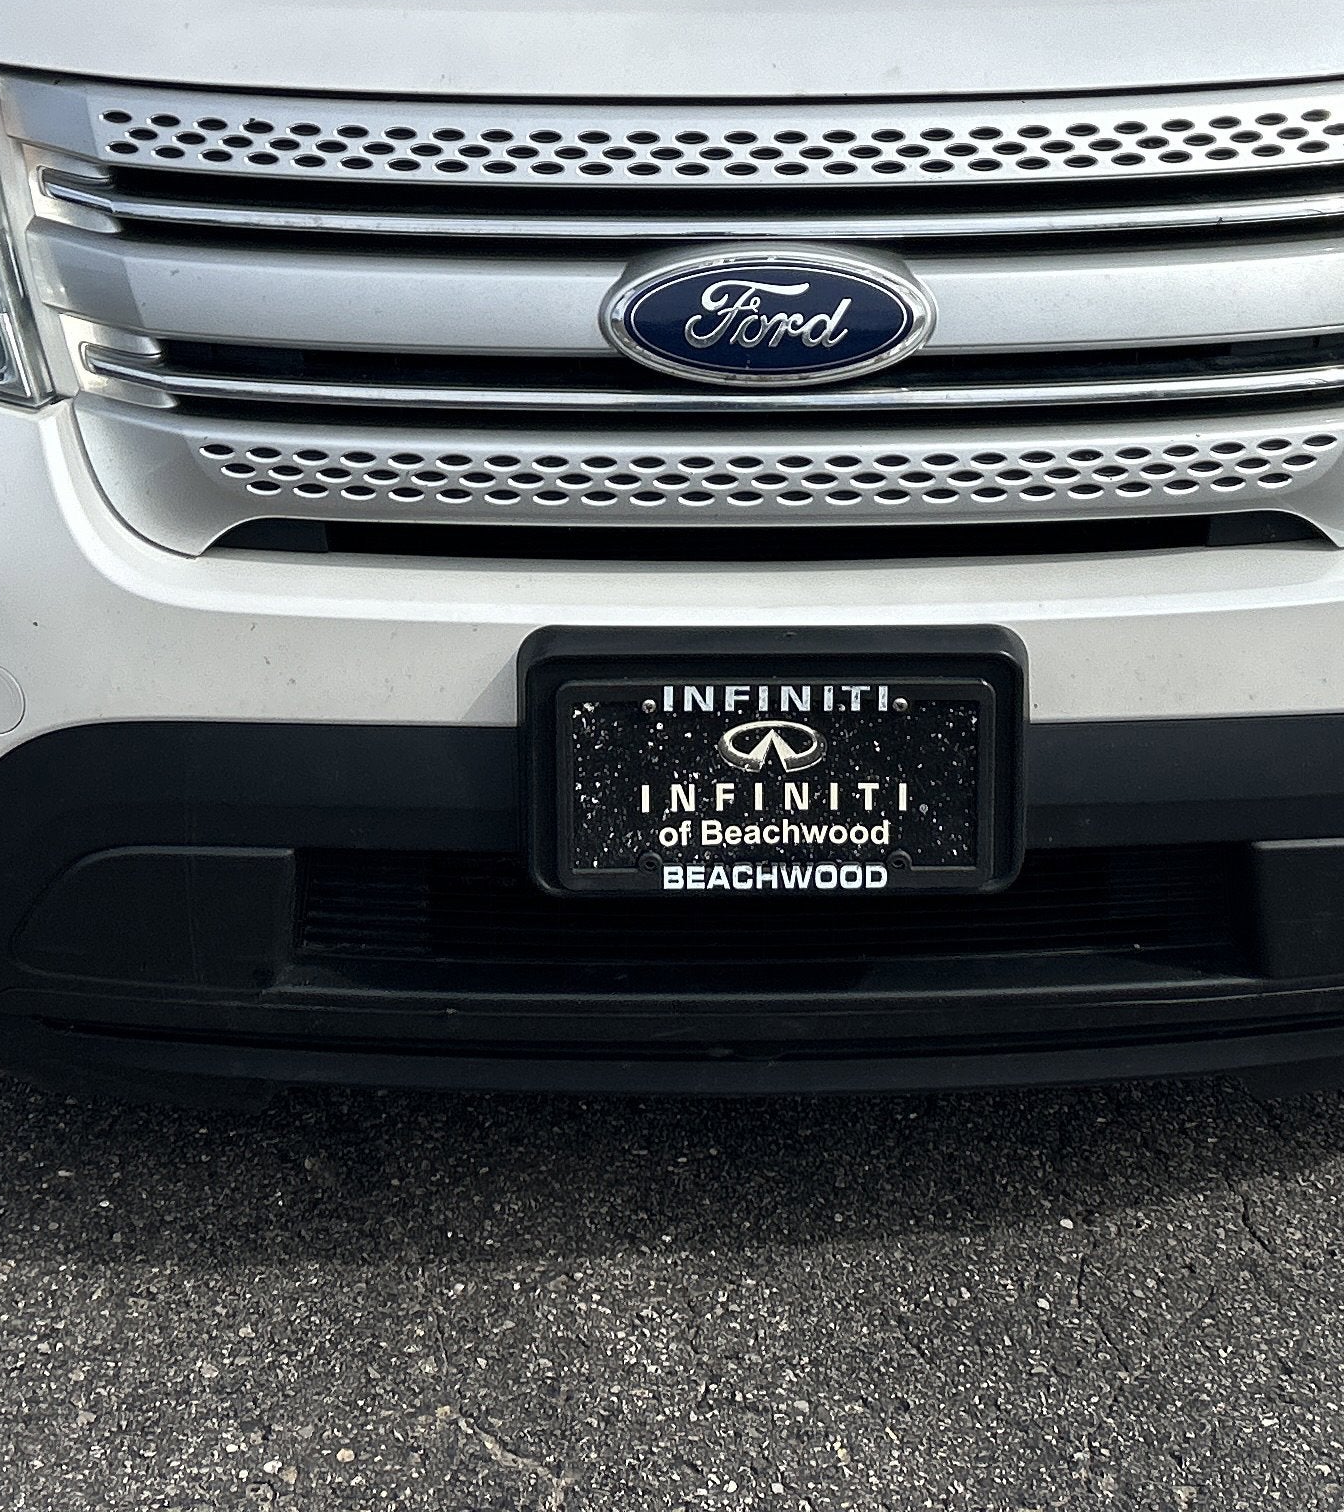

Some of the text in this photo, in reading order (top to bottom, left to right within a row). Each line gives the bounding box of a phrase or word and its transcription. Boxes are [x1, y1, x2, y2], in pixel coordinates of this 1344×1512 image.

[684, 279, 852, 349] Ford
[663, 686, 889, 712] INFINITI
[641, 783, 907, 813] INFINITI
[658, 819, 890, 847] of Beachwood
[663, 864, 889, 890] BEACHWOOD
